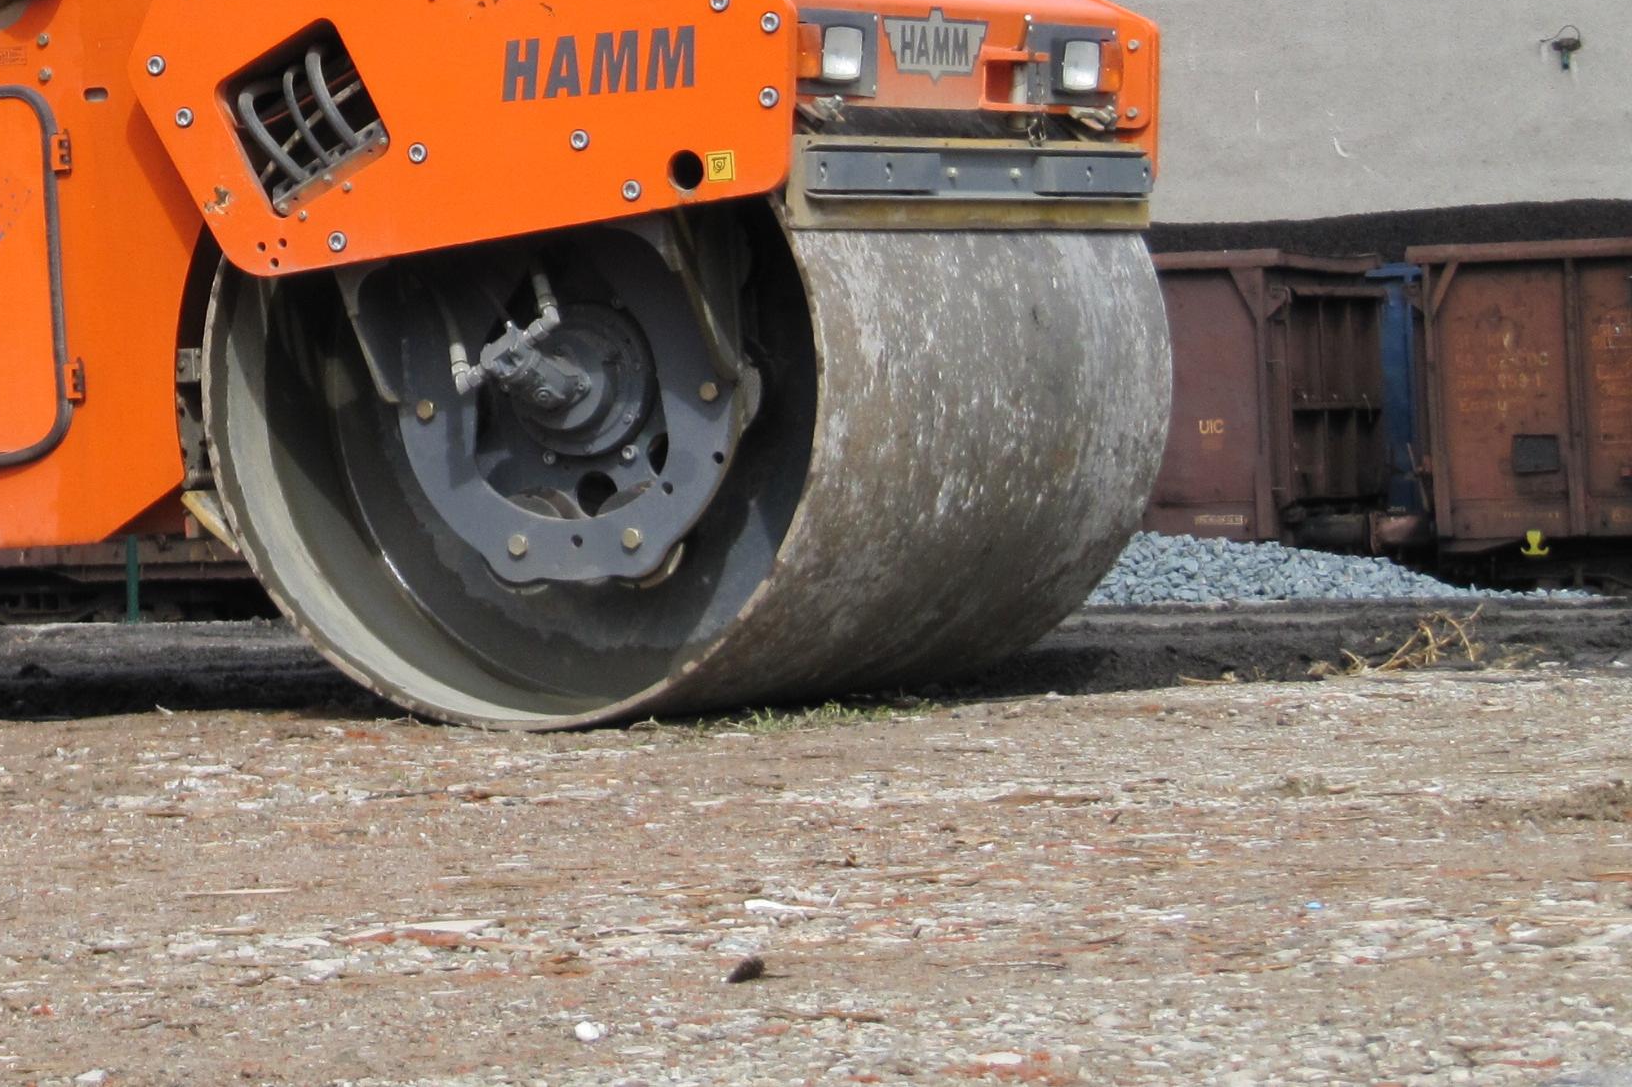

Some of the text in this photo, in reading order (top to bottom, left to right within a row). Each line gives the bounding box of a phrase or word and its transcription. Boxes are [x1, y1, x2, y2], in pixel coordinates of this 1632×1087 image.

[502, 25, 695, 102] HAMM
[900, 24, 969, 66] HAMM
[1198, 418, 1224, 434] UIC
